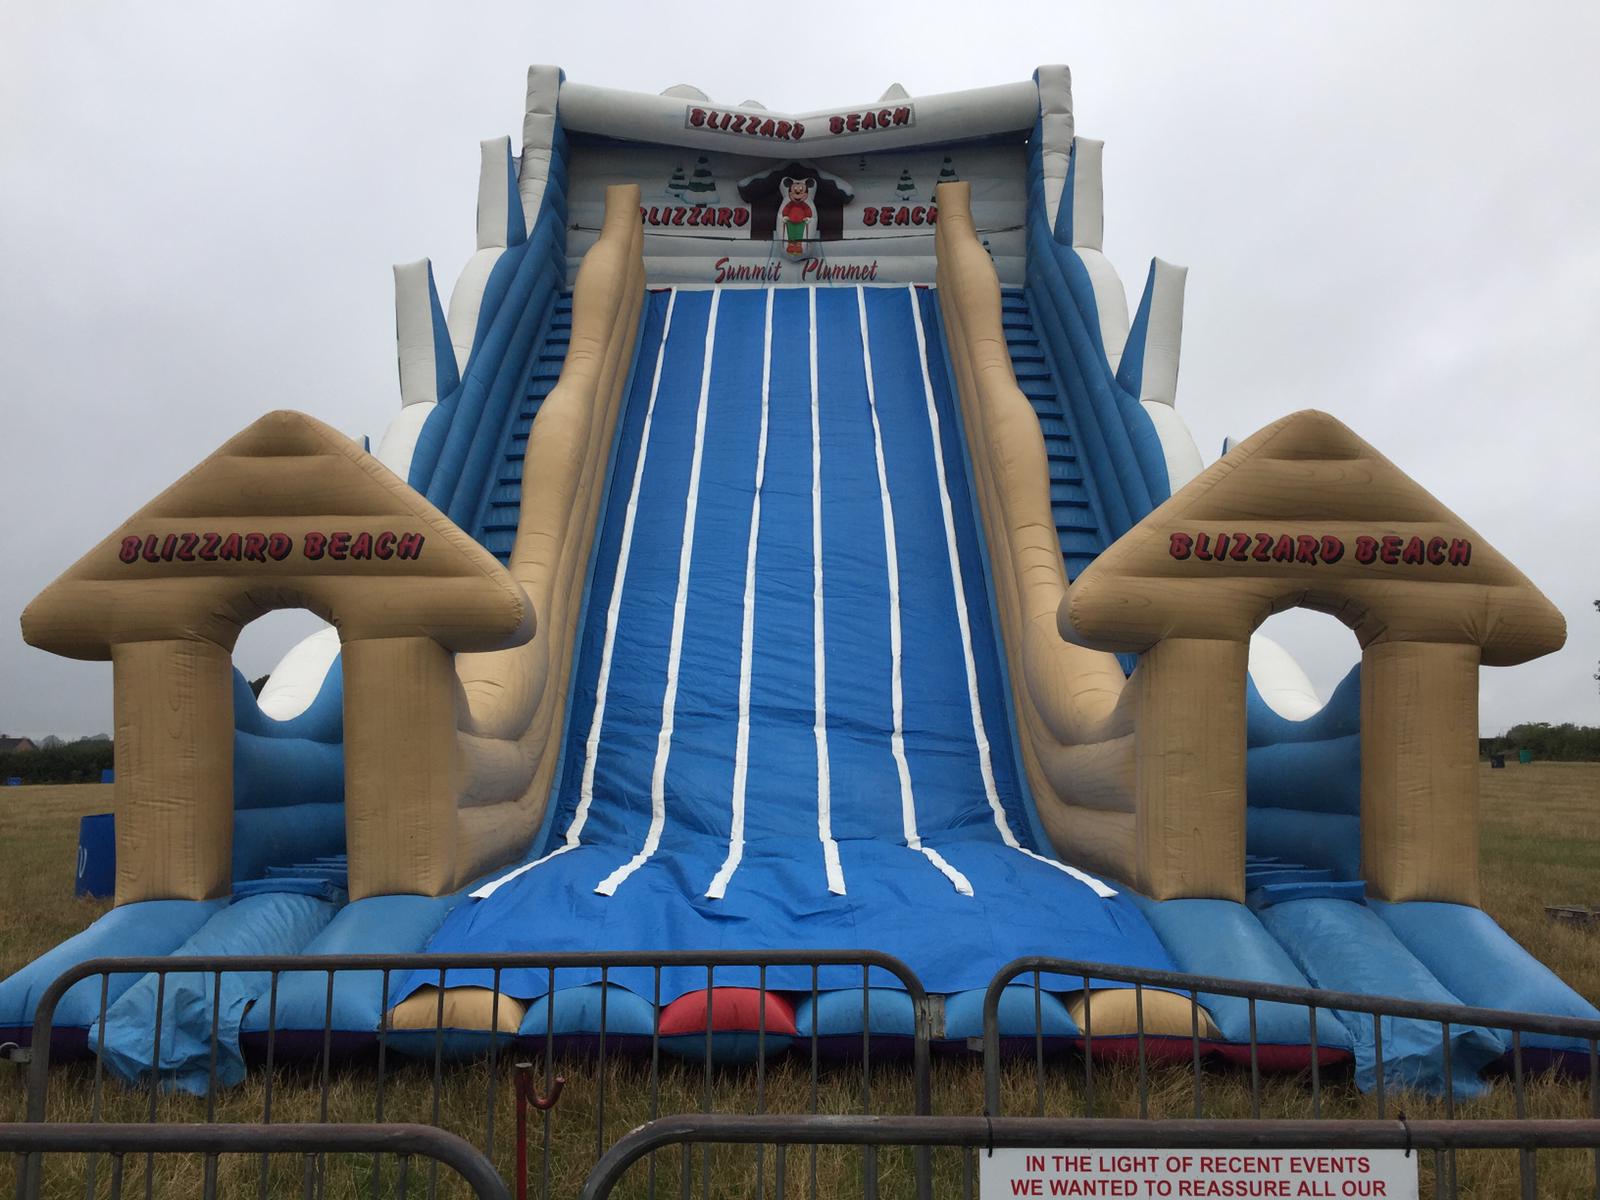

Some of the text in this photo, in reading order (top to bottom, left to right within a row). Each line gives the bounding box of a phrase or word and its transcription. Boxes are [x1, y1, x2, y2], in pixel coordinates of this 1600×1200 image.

[690, 106, 911, 140] BLIZZARD BEACH
[714, 257, 878, 283] Summit Plummet
[119, 531, 425, 563] BLIZZARD BEACH
[1169, 532, 1472, 566] BLIZZARD BEACH
[1026, 1155, 1371, 1174] IN THE LIGHT OF RECENT EVENTS
[1011, 1179, 1387, 1197] WE WANTED TO REASSURE ALL OUR
